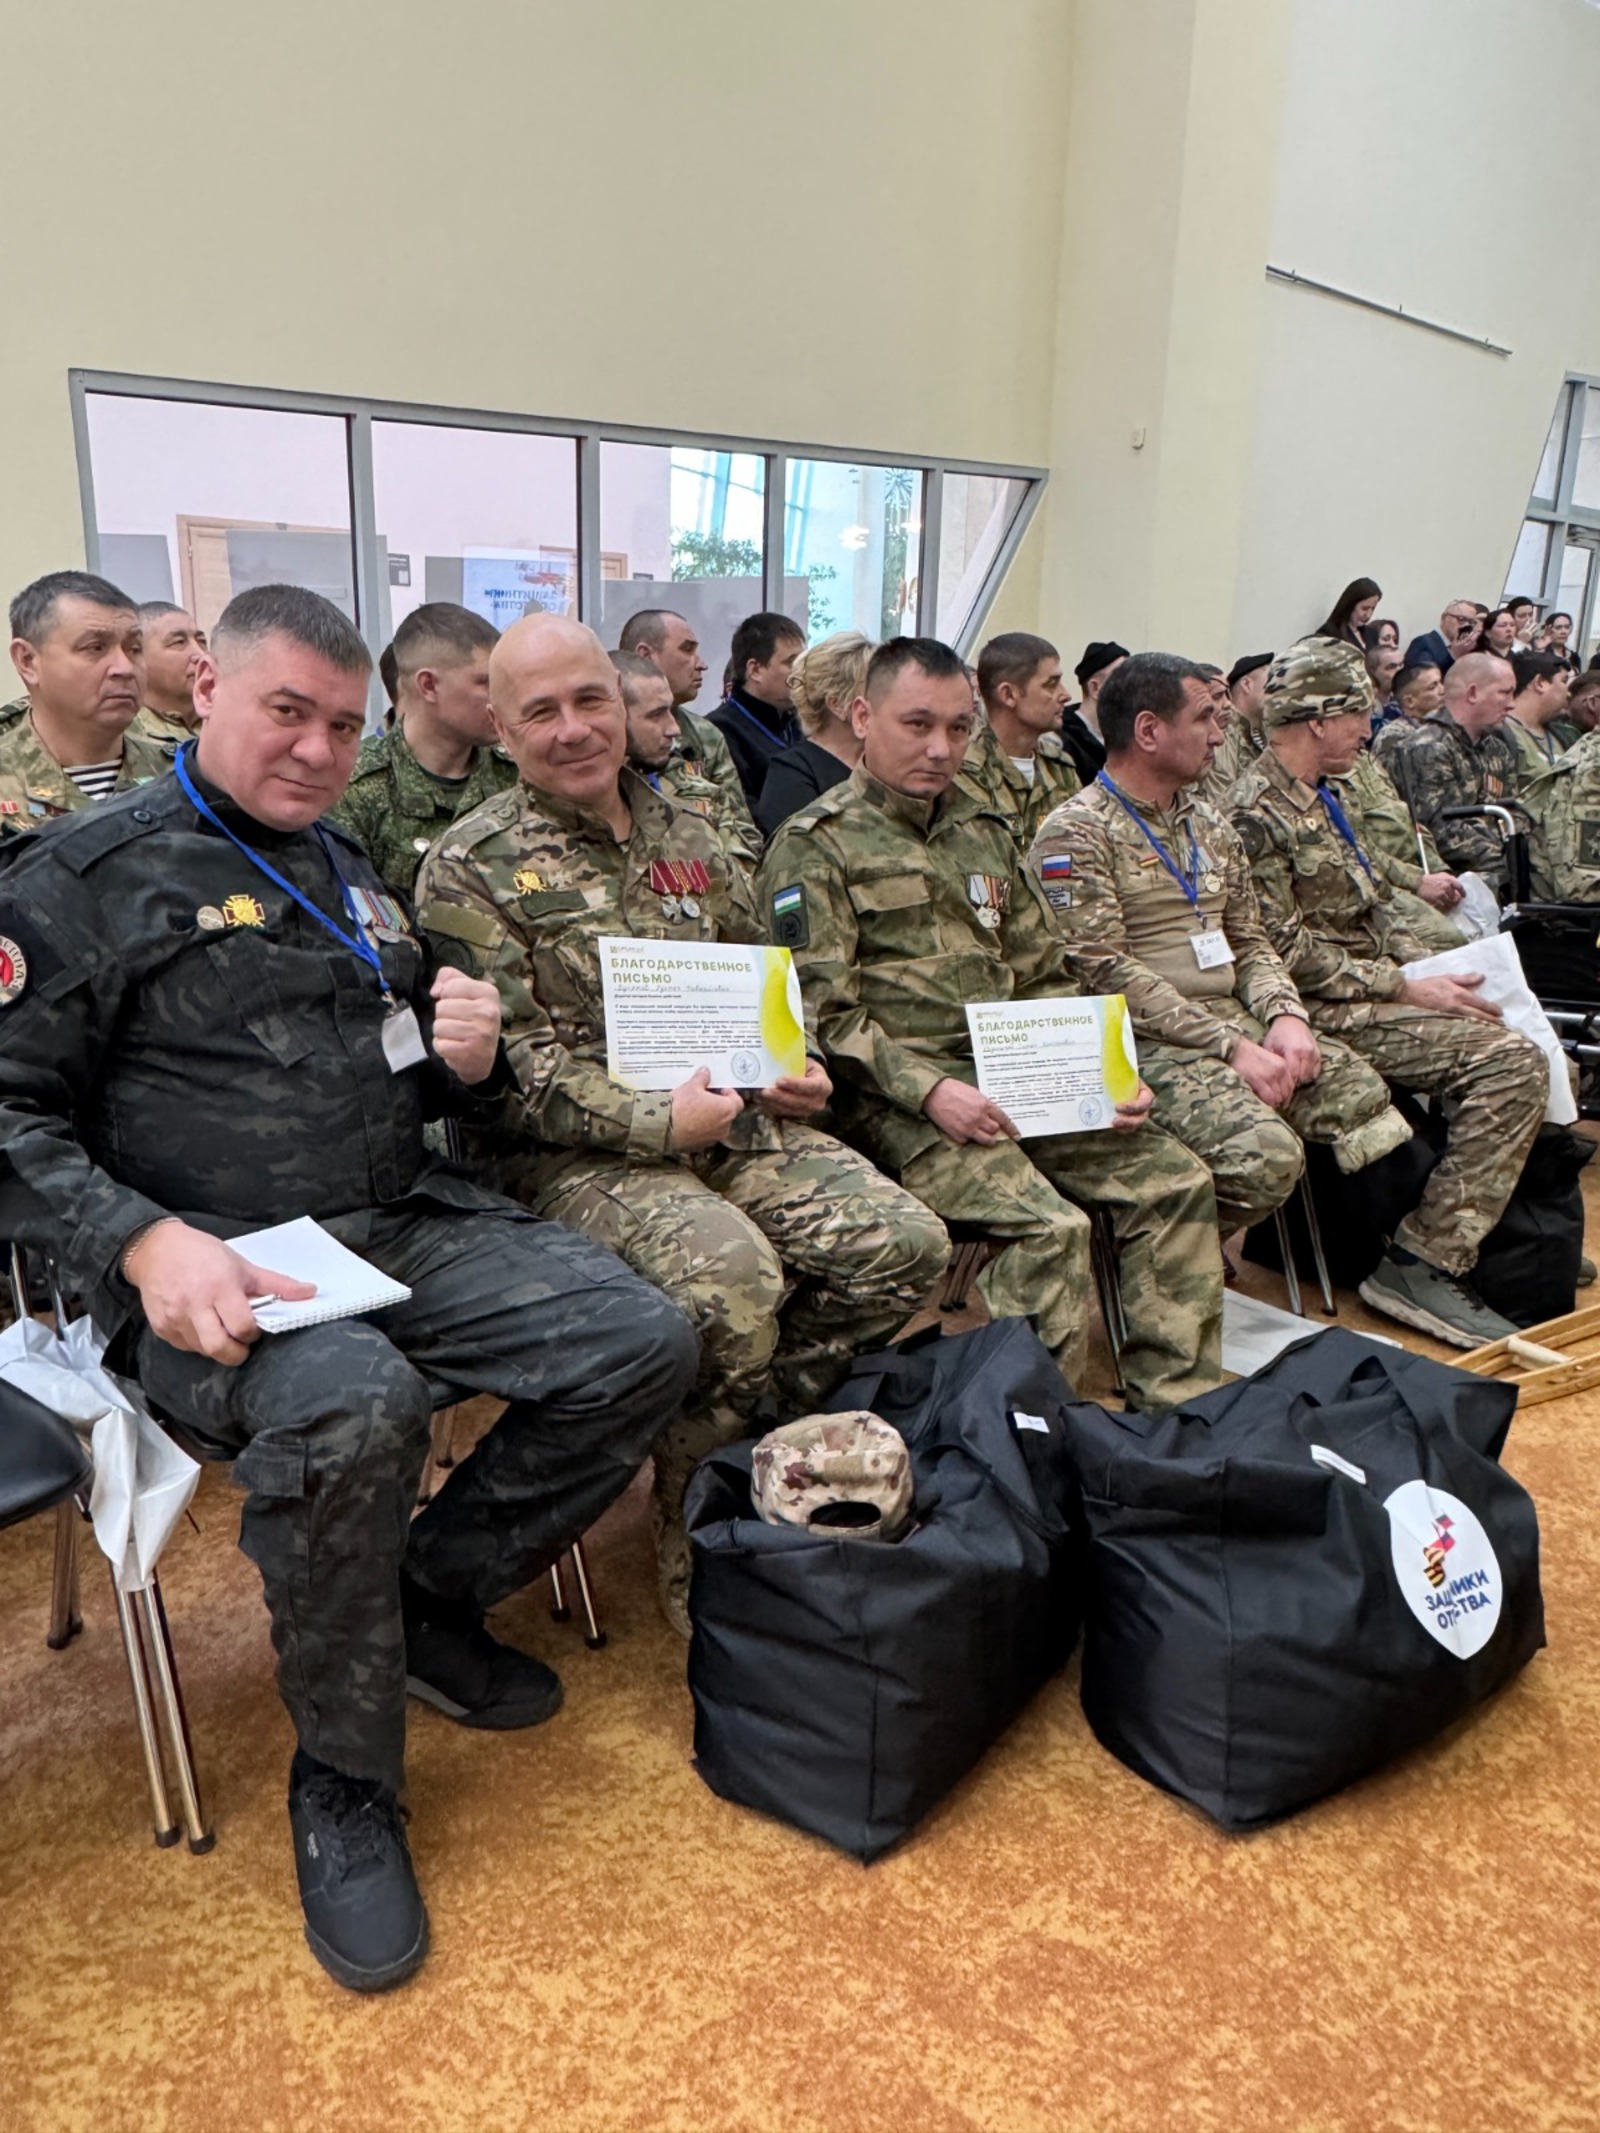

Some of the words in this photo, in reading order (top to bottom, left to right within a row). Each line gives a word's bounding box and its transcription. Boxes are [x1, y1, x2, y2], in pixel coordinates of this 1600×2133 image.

[611, 958, 752, 973] БЛАГОДАРСТВЕННОЕ
[613, 973, 672, 984] ПИСЬМО
[977, 1015, 1094, 1032] БЛАГОДАРСТВЕННОЕ
[980, 1034, 1028, 1045] ПИСЬМО
